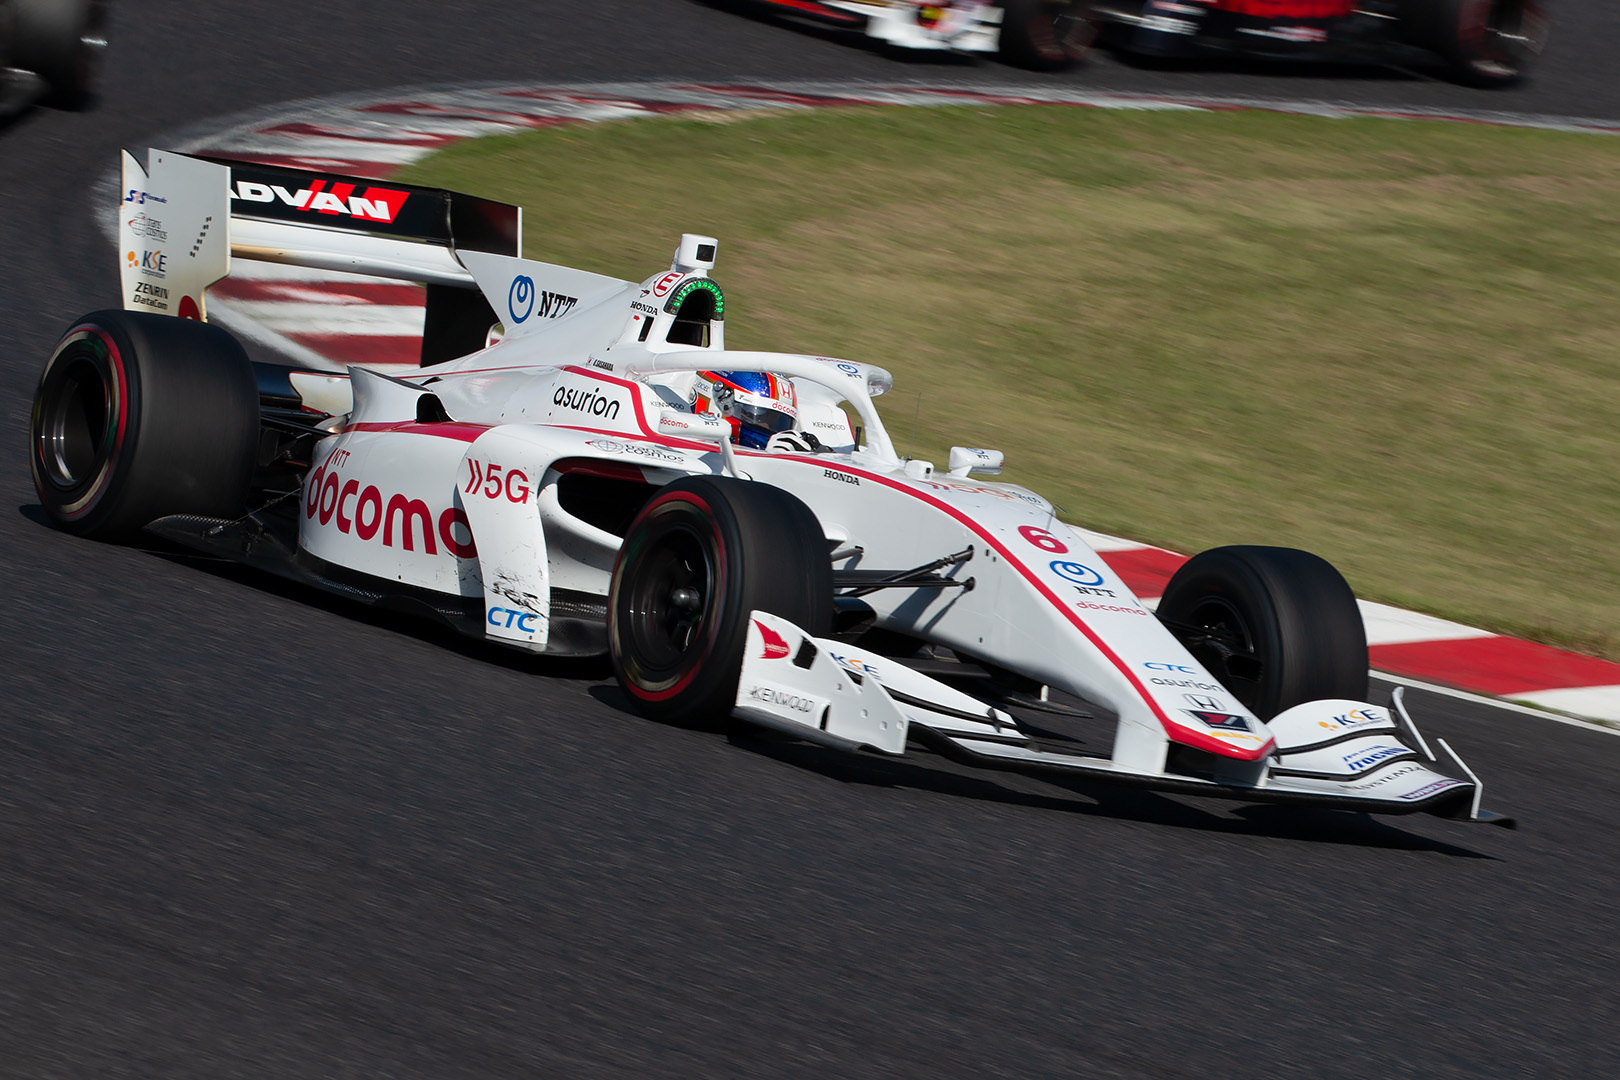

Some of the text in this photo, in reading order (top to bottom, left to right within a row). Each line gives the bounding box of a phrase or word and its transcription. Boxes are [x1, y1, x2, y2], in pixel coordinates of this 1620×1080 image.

[230, 180, 391, 221] DVAN
[142, 250, 167, 273] KSE
[135, 281, 170, 300] ZENRIN
[133, 294, 169, 311] DataCom
[537, 290, 578, 319] NTT
[630, 300, 658, 316] HONDA
[553, 386, 621, 421] asurion
[650, 400, 685, 411] KENWOOD
[660, 417, 689, 430] docomo
[811, 421, 846, 432] KENWOOD
[331, 447, 351, 469] NTT
[484, 463, 530, 505] 5G
[823, 469, 861, 486] HONDA
[306, 448, 479, 560] docomo
[1017, 525, 1069, 555] 6
[1073, 585, 1117, 599] NTT
[1076, 601, 1148, 616] docomo
[487, 606, 541, 634] CTC
[1143, 662, 1197, 675] CTC
[1150, 677, 1225, 693] asurion
[750, 685, 816, 713] KENWOOD
[1332, 708, 1379, 726] KSE
